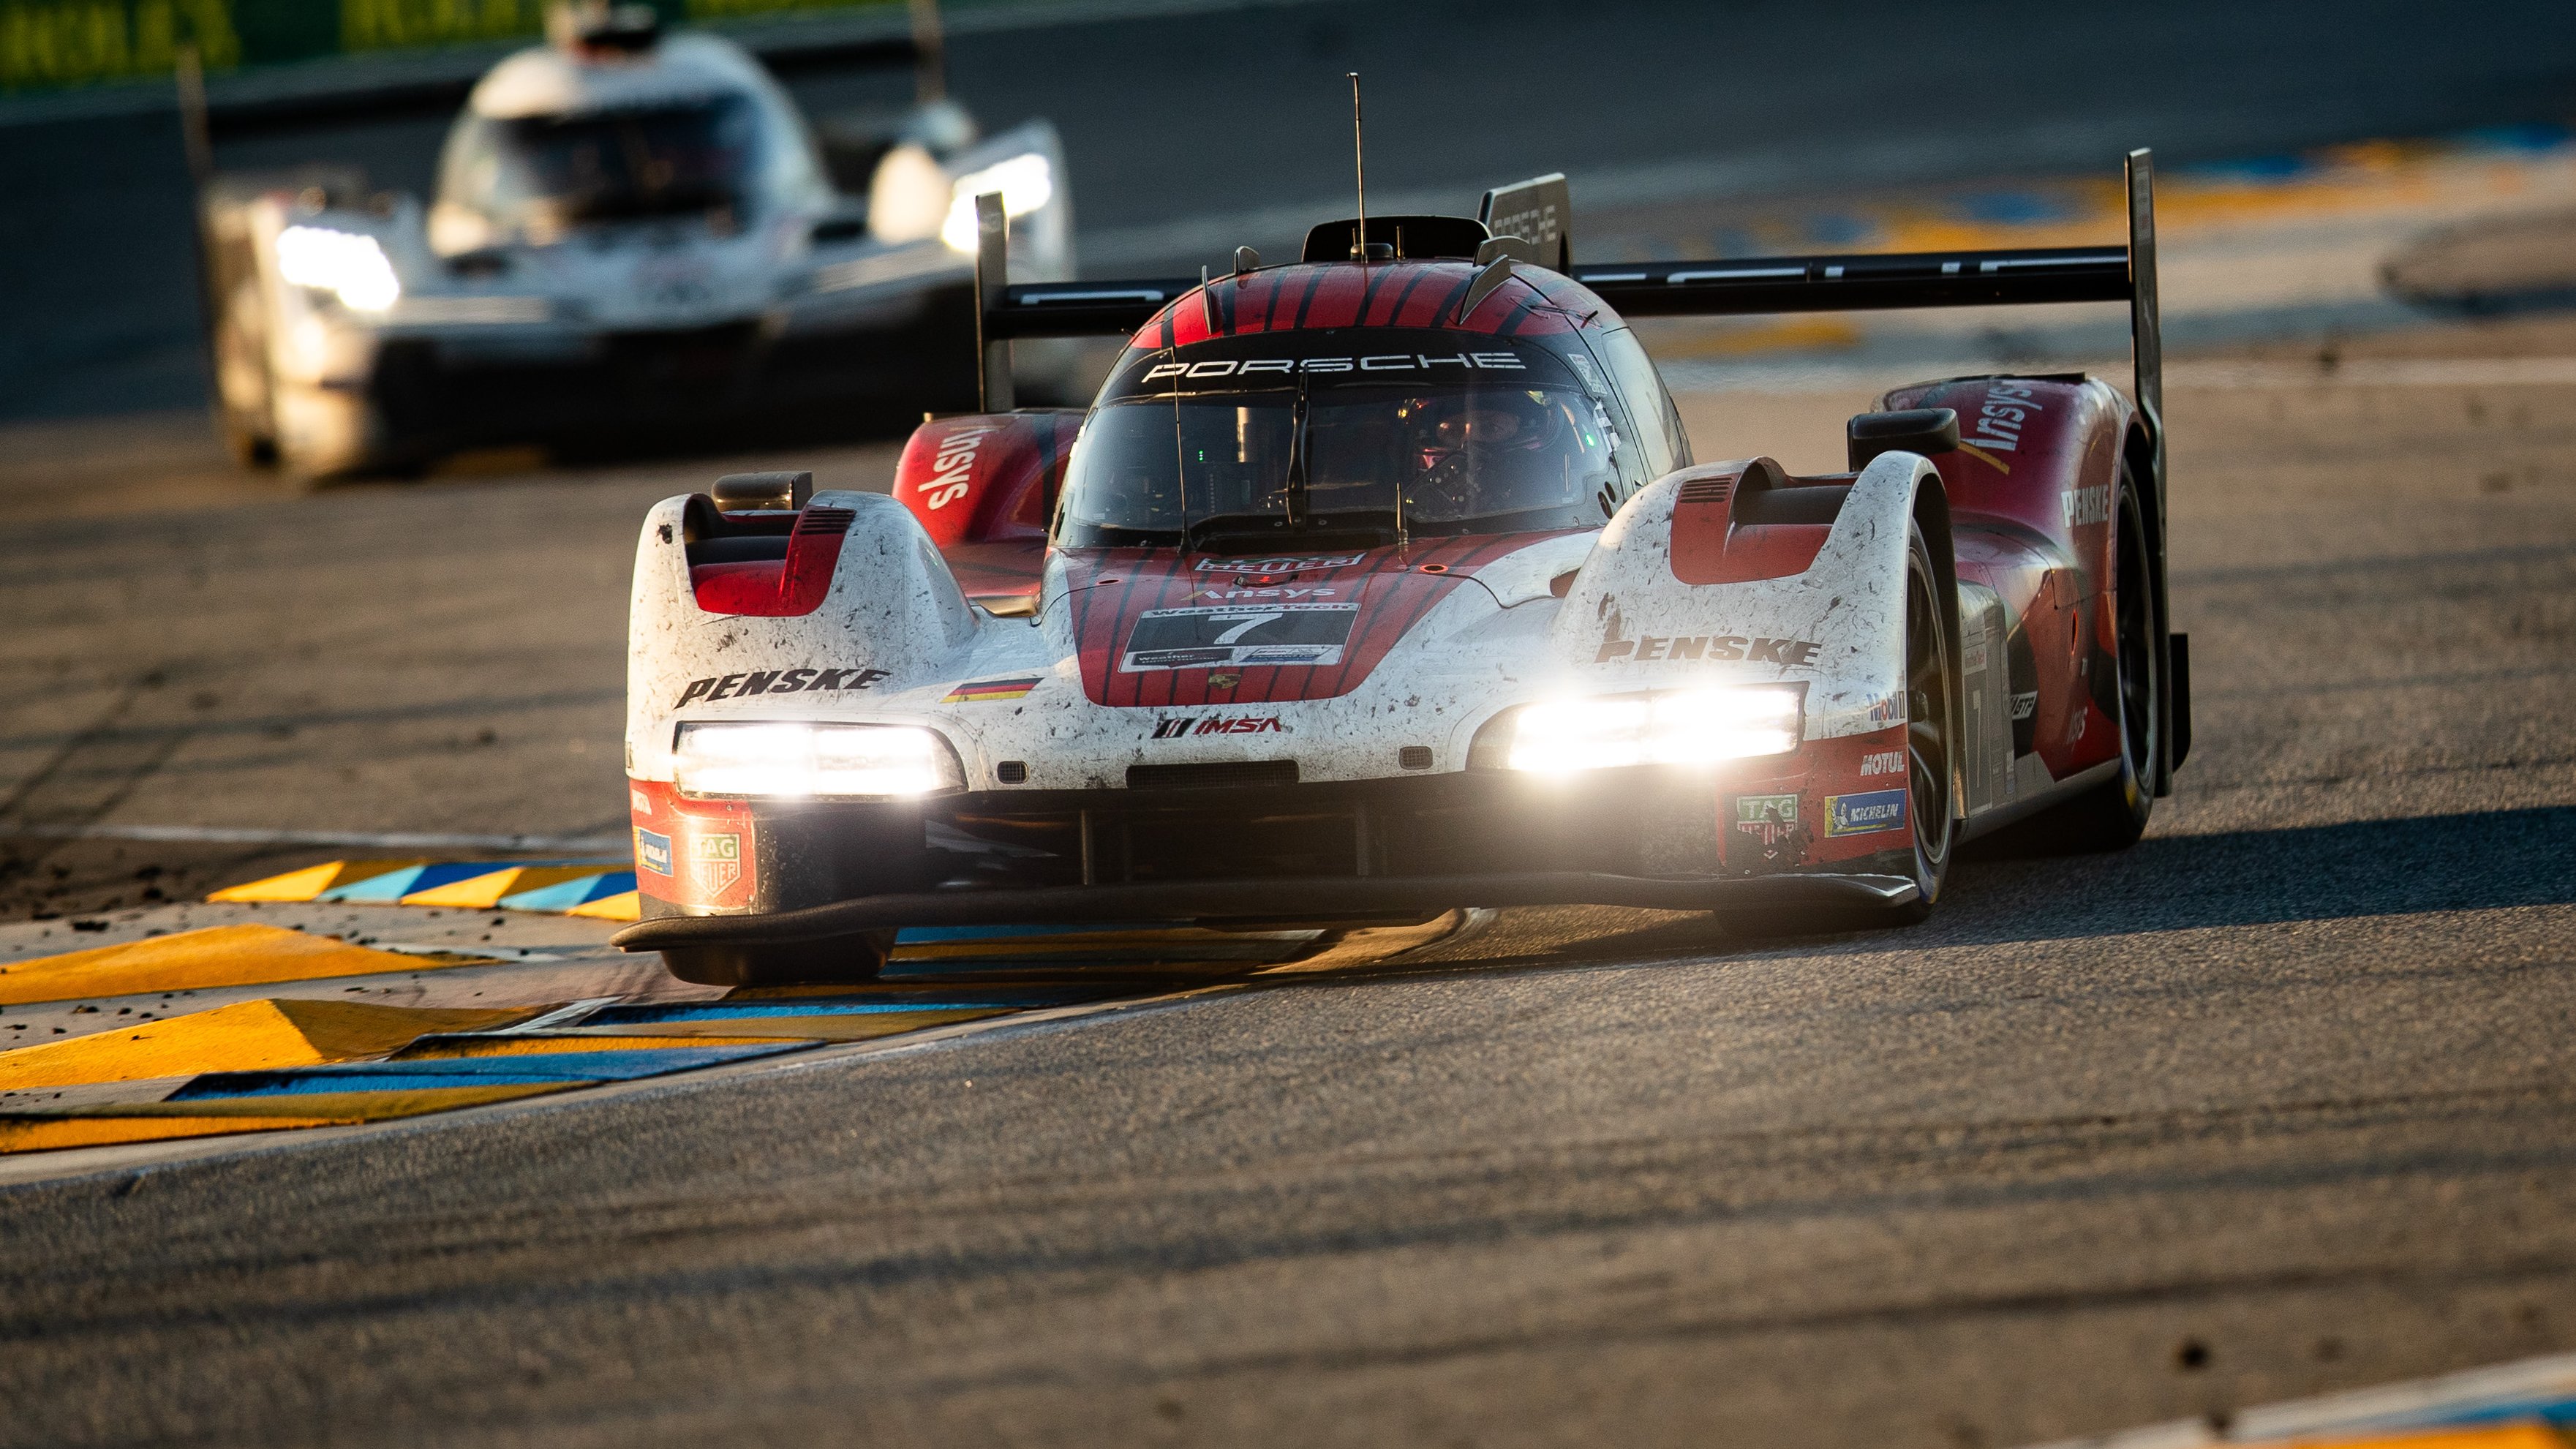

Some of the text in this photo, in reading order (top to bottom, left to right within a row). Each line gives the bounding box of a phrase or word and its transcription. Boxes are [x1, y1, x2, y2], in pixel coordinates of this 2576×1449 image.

[1142, 353, 1526, 383] PORSCHE
[2061, 484, 2108, 528] PENSKE
[1180, 587, 1335, 601] Ansys
[1208, 612, 1282, 644] 7
[1595, 636, 1822, 666] PENSKE
[674, 669, 892, 710] PENSKE
[1193, 718, 1281, 735] IMSA
[1860, 751, 1905, 776] MOTUL
[1742, 798, 1793, 819] TAG
[1850, 802, 1899, 823] MICHELIN
[692, 838, 734, 857] TAG
